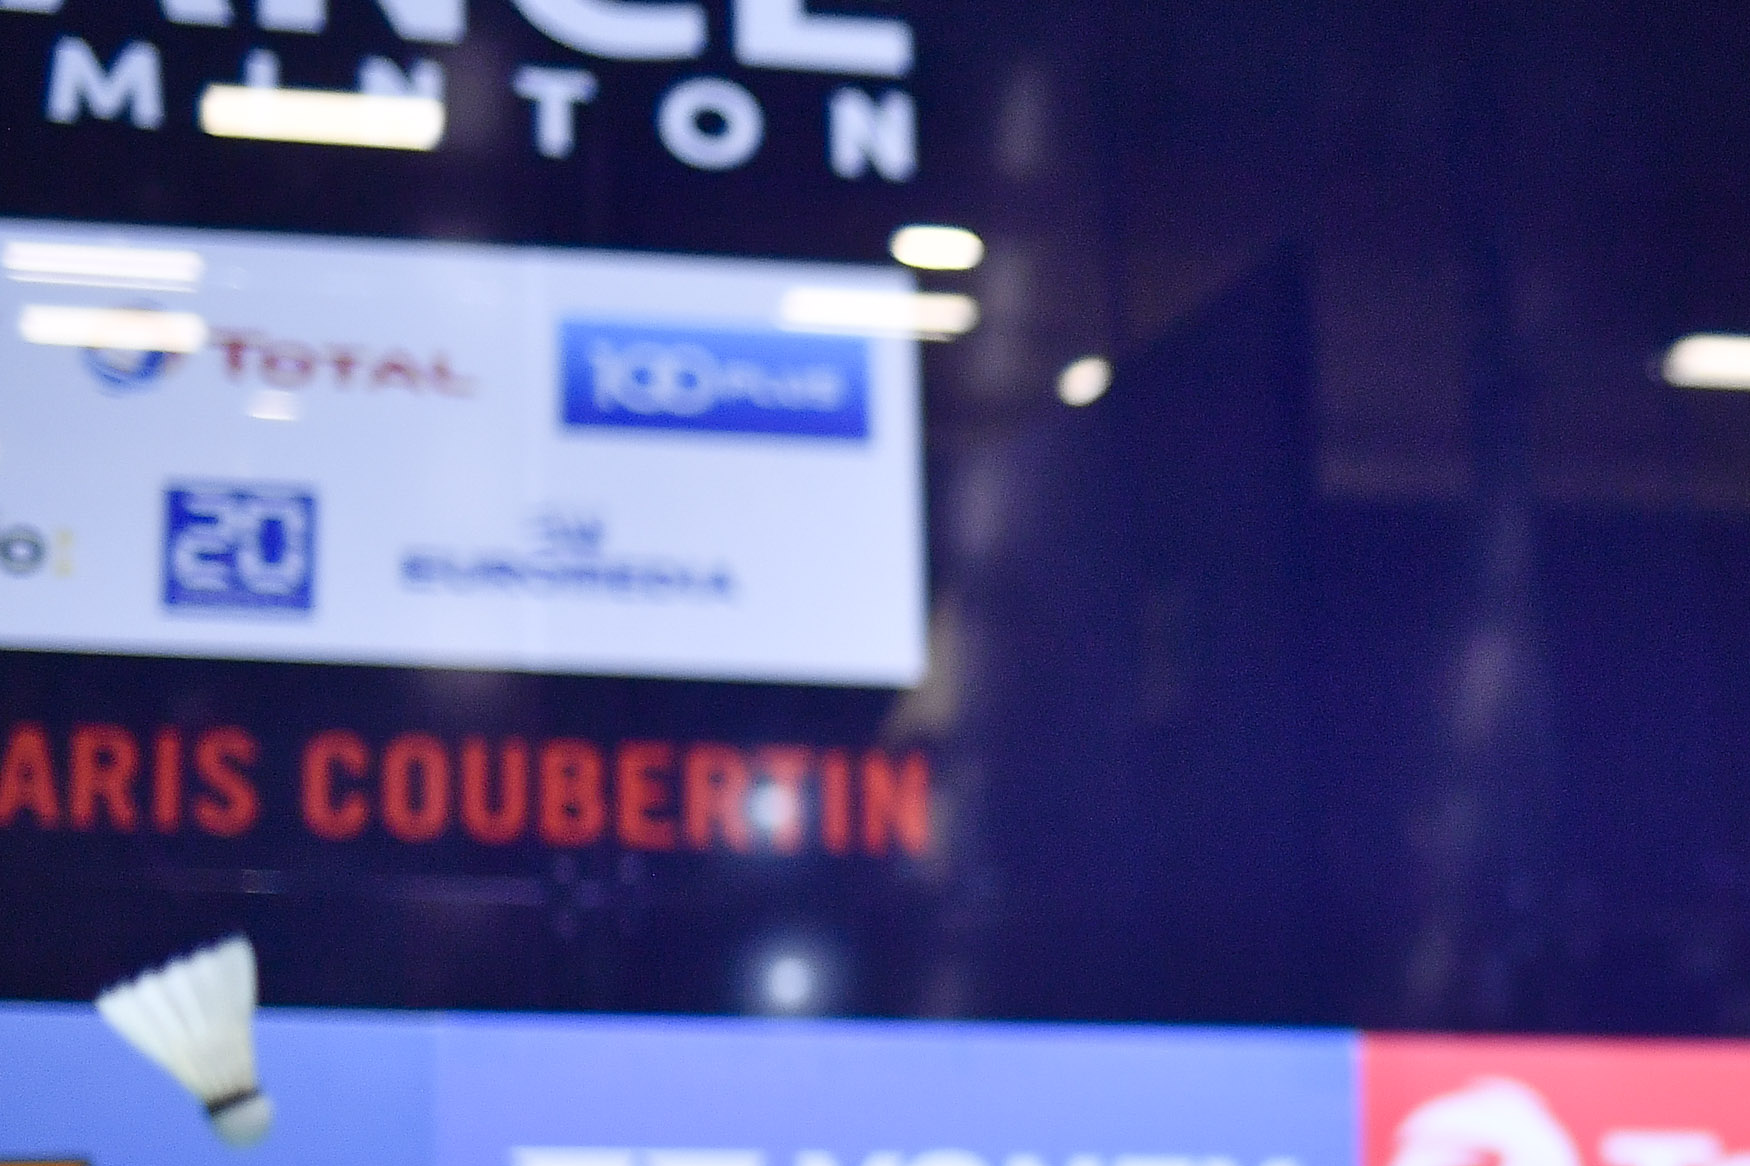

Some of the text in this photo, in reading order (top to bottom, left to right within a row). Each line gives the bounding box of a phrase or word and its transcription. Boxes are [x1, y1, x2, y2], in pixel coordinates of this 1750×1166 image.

[176, 496, 306, 595] 20
[0, 721, 931, 854] ARIS COUBERTIN
